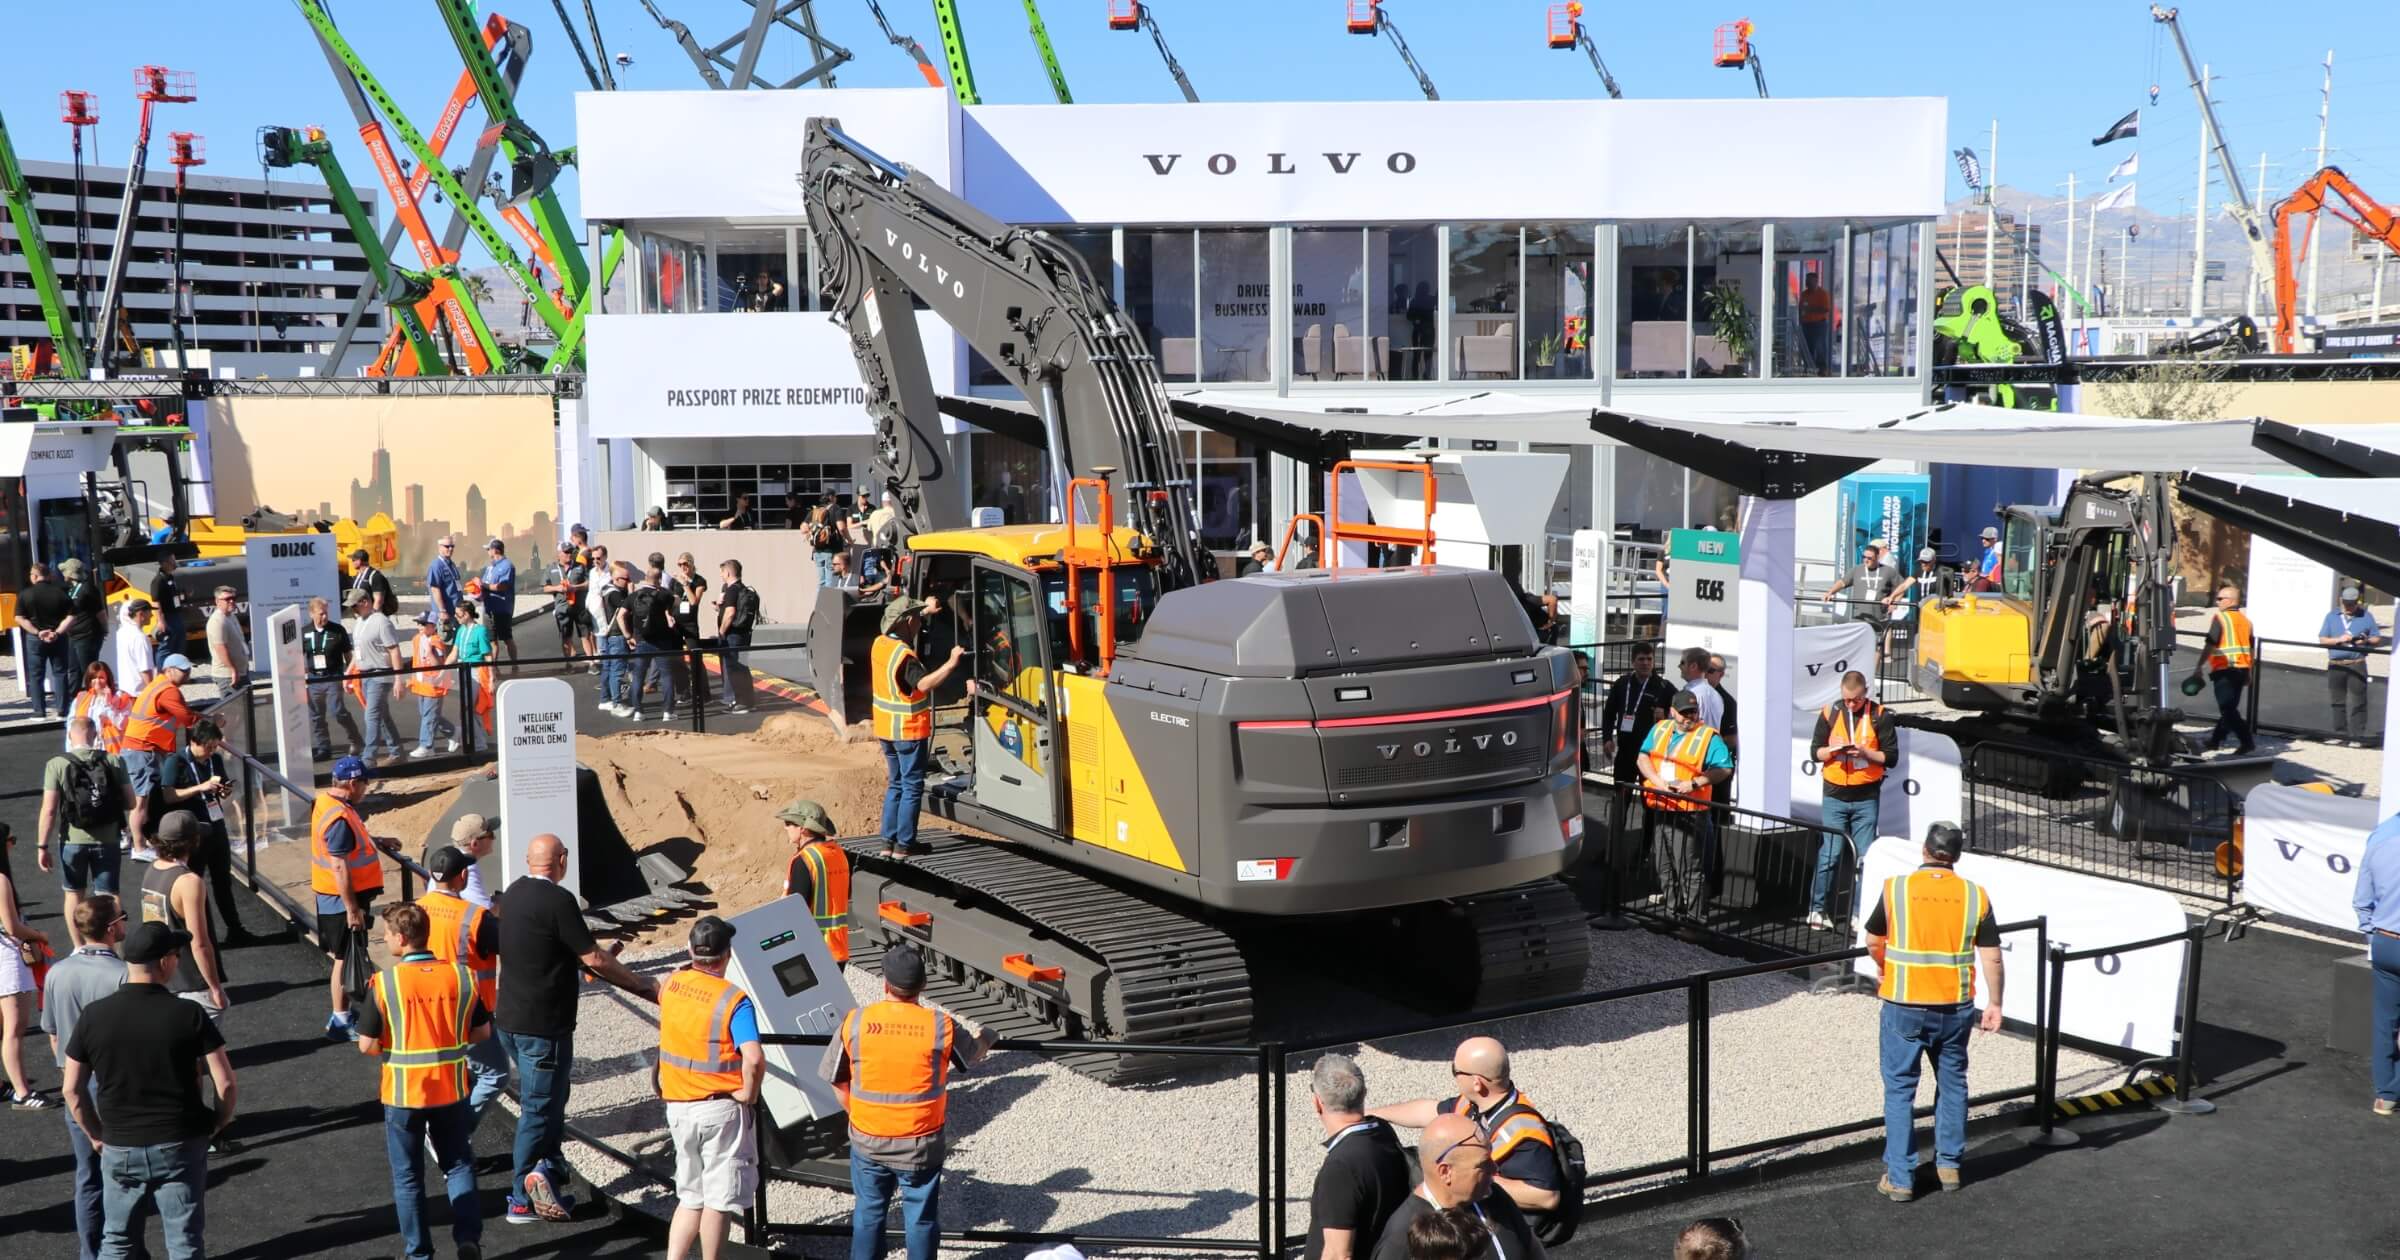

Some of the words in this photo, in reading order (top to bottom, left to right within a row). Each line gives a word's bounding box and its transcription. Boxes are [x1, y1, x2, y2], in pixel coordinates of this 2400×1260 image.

[1142, 151, 1417, 176] VOLVO
[885, 227, 964, 299] VOLVO
[502, 260, 539, 304] MERLO
[1237, 284, 1270, 297] DRIVE
[1215, 303, 1268, 317] BUSINESS
[1293, 303, 1326, 316] WARD
[399, 306, 423, 343] ERLO
[667, 389, 737, 407] PASSPORT
[743, 388, 781, 406] PRIZE
[786, 387, 865, 405] REDEMPTIO
[31, 450, 54, 460] COMPACT
[56, 449, 74, 459] ASSIST
[1883, 495, 1892, 518] AND
[1890, 495, 1901, 553] WORKSHOP
[1698, 540, 1725, 556] NEW
[1696, 578, 1725, 602] EC65
[518, 711, 563, 723] INTELLIGENT
[1150, 711, 1190, 728] ELECTRIC
[524, 723, 557, 734] MACHINE
[513, 735, 545, 747] CONTROL
[547, 734, 568, 744] DEMO
[1377, 730, 1518, 760] VOLVO
